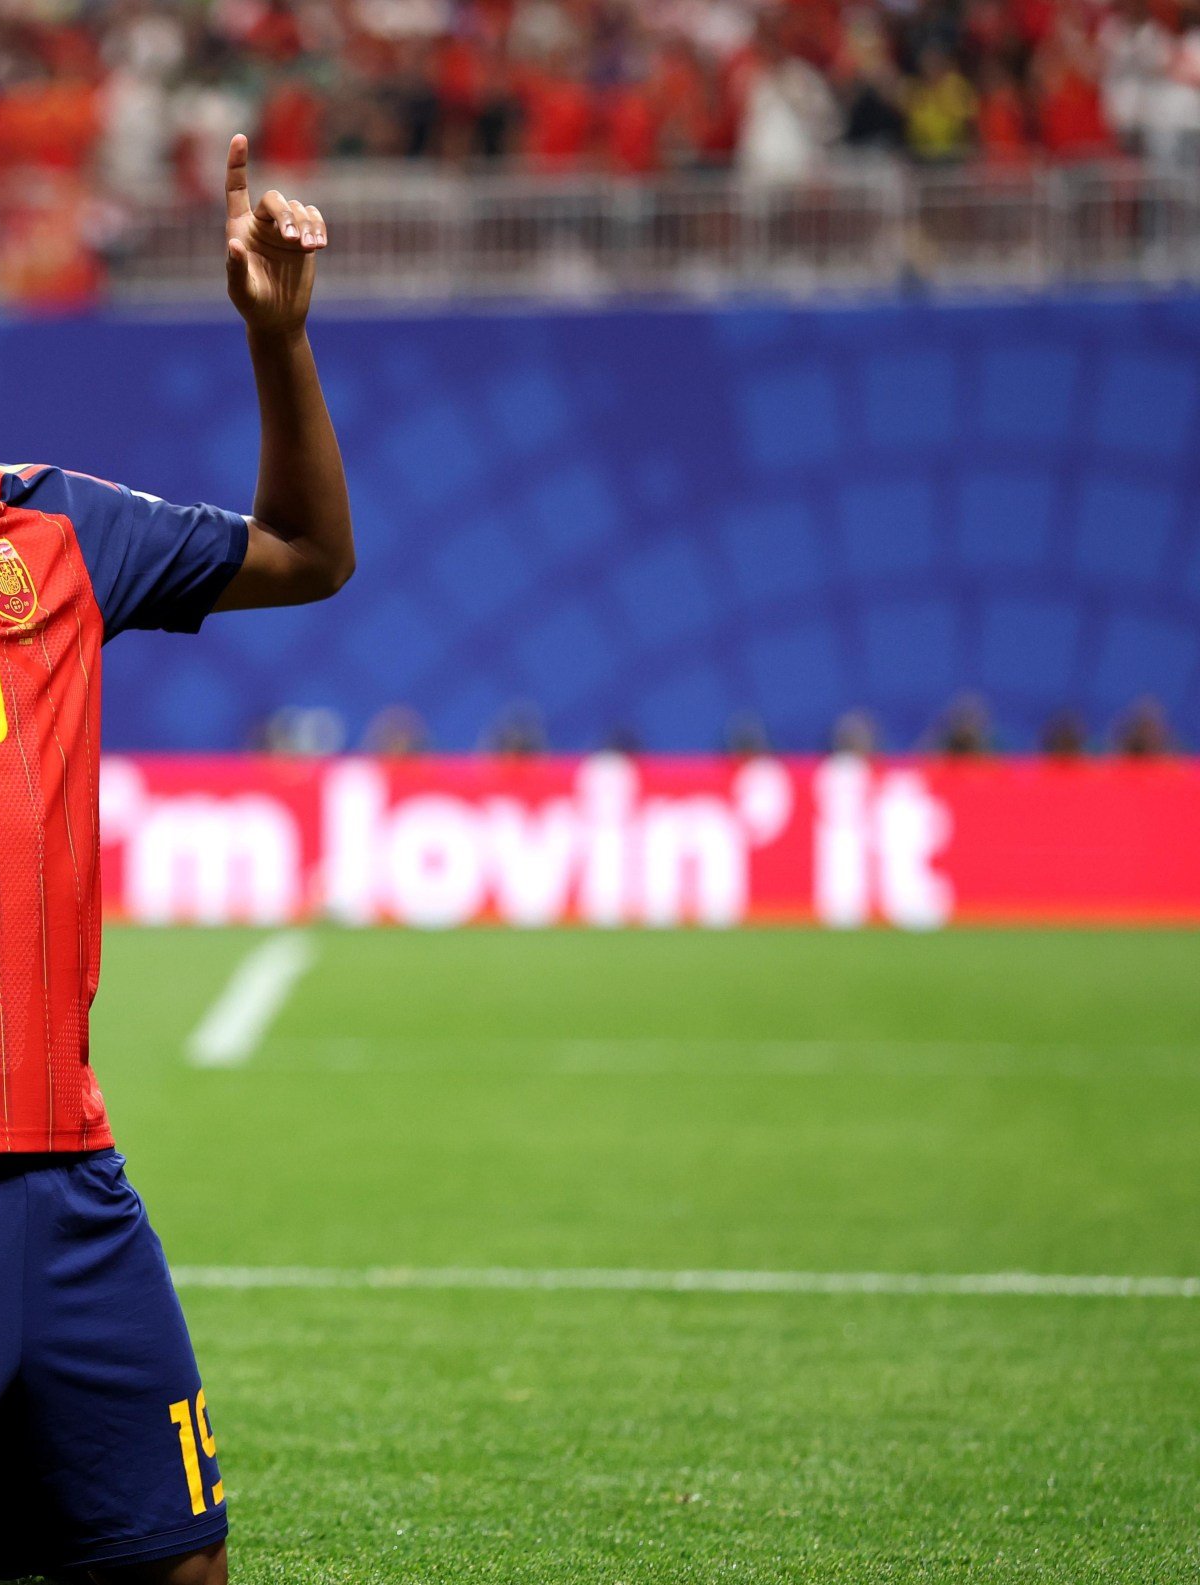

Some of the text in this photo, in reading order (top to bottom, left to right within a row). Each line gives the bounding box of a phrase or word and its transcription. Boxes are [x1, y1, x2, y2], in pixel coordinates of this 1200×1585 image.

[99, 752, 955, 929] 'm lovin' it
